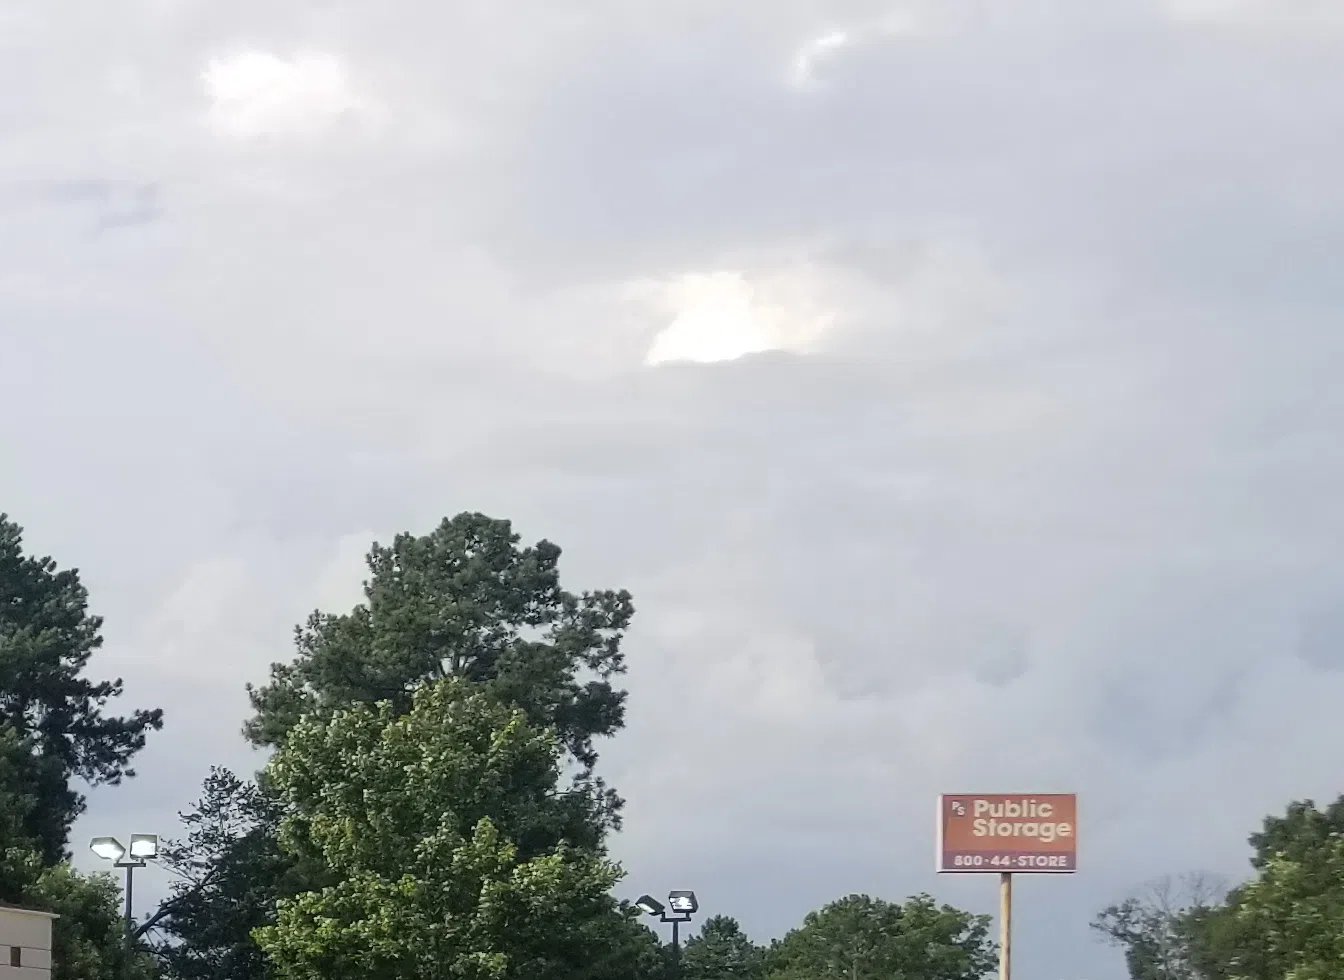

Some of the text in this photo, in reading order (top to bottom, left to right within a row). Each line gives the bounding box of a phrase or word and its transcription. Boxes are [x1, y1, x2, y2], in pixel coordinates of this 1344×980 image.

[973, 799, 1053, 818] Public
[973, 819, 1072, 843] Storage
[954, 855, 1067, 867] 800-44-STORE
